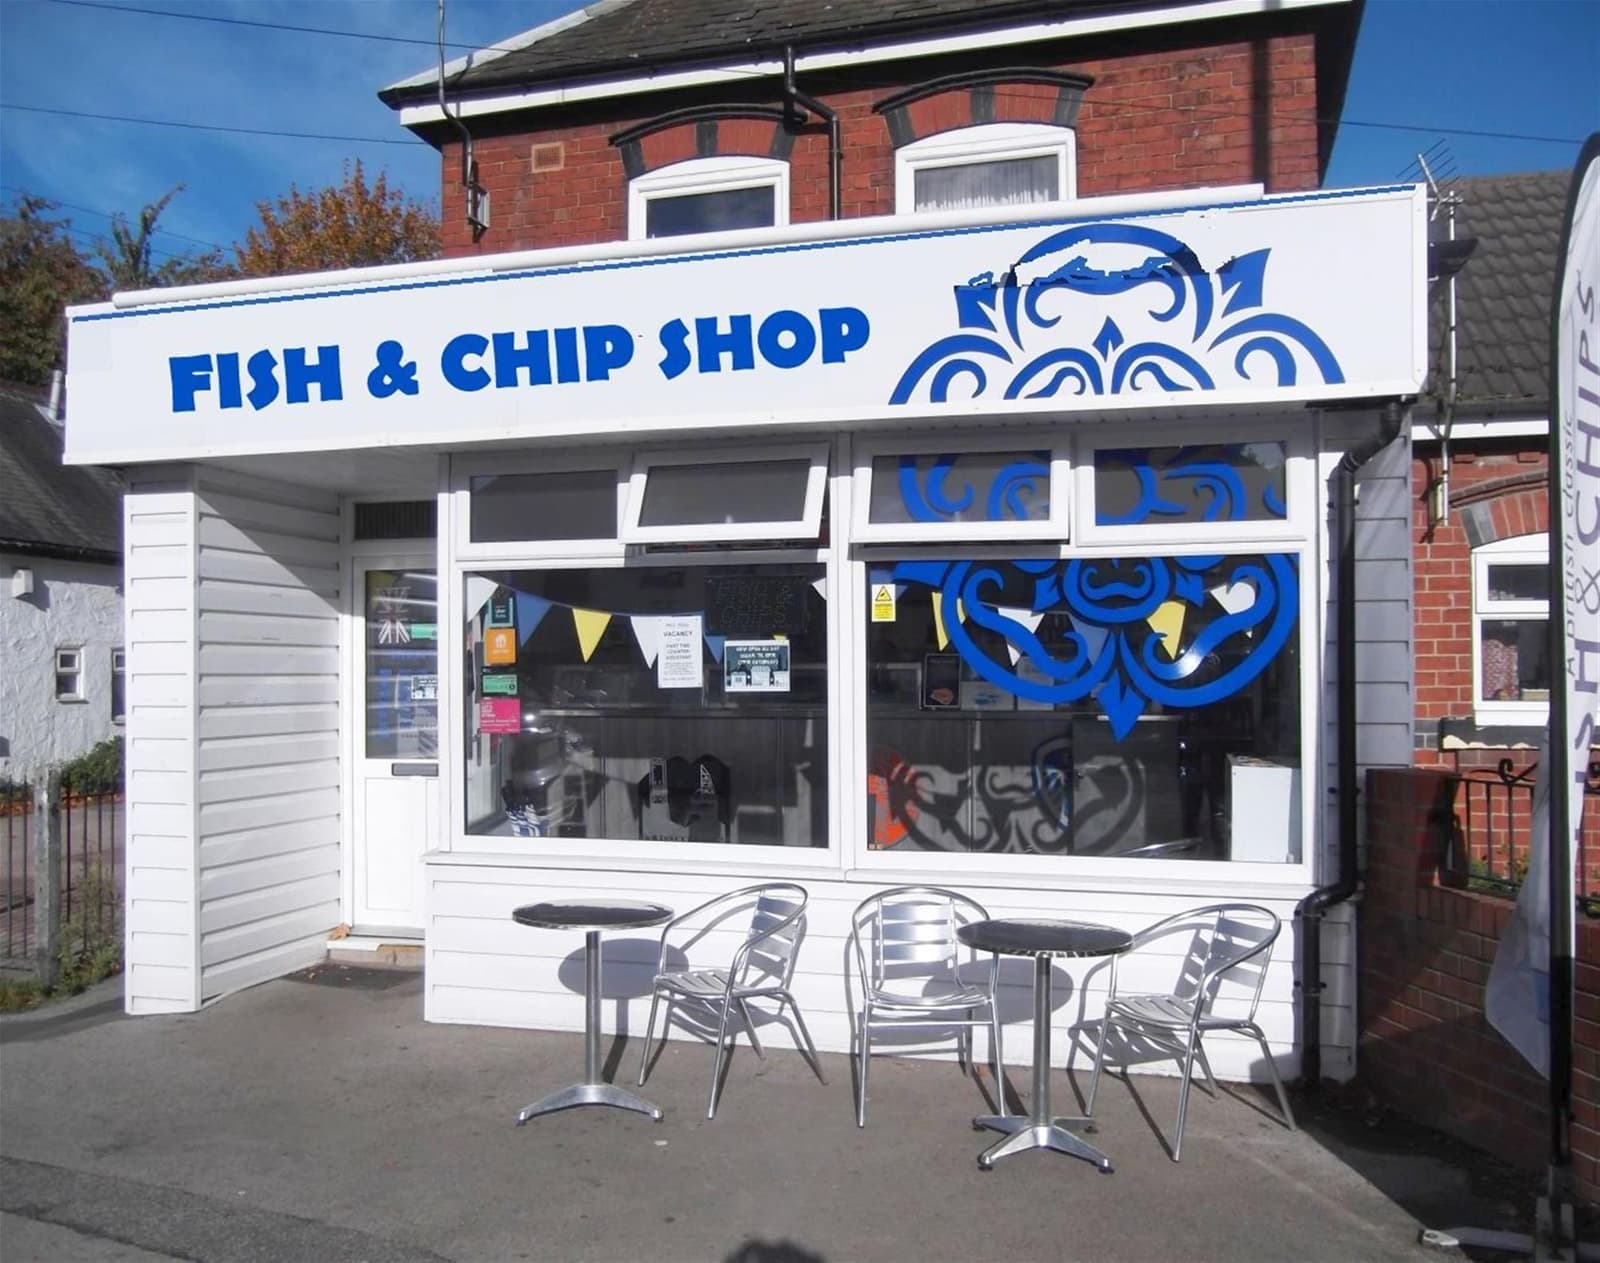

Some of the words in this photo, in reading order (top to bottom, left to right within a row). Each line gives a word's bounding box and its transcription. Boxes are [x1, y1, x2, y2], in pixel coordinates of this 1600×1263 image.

[169, 345, 343, 413] FISH
[367, 340, 419, 399] &
[441, 324, 634, 392] CHIP
[659, 307, 870, 380] SHOP
[1576, 268, 1600, 546] CHIPS
[1563, 410, 1574, 518] classic
[1575, 566, 1600, 616] &
